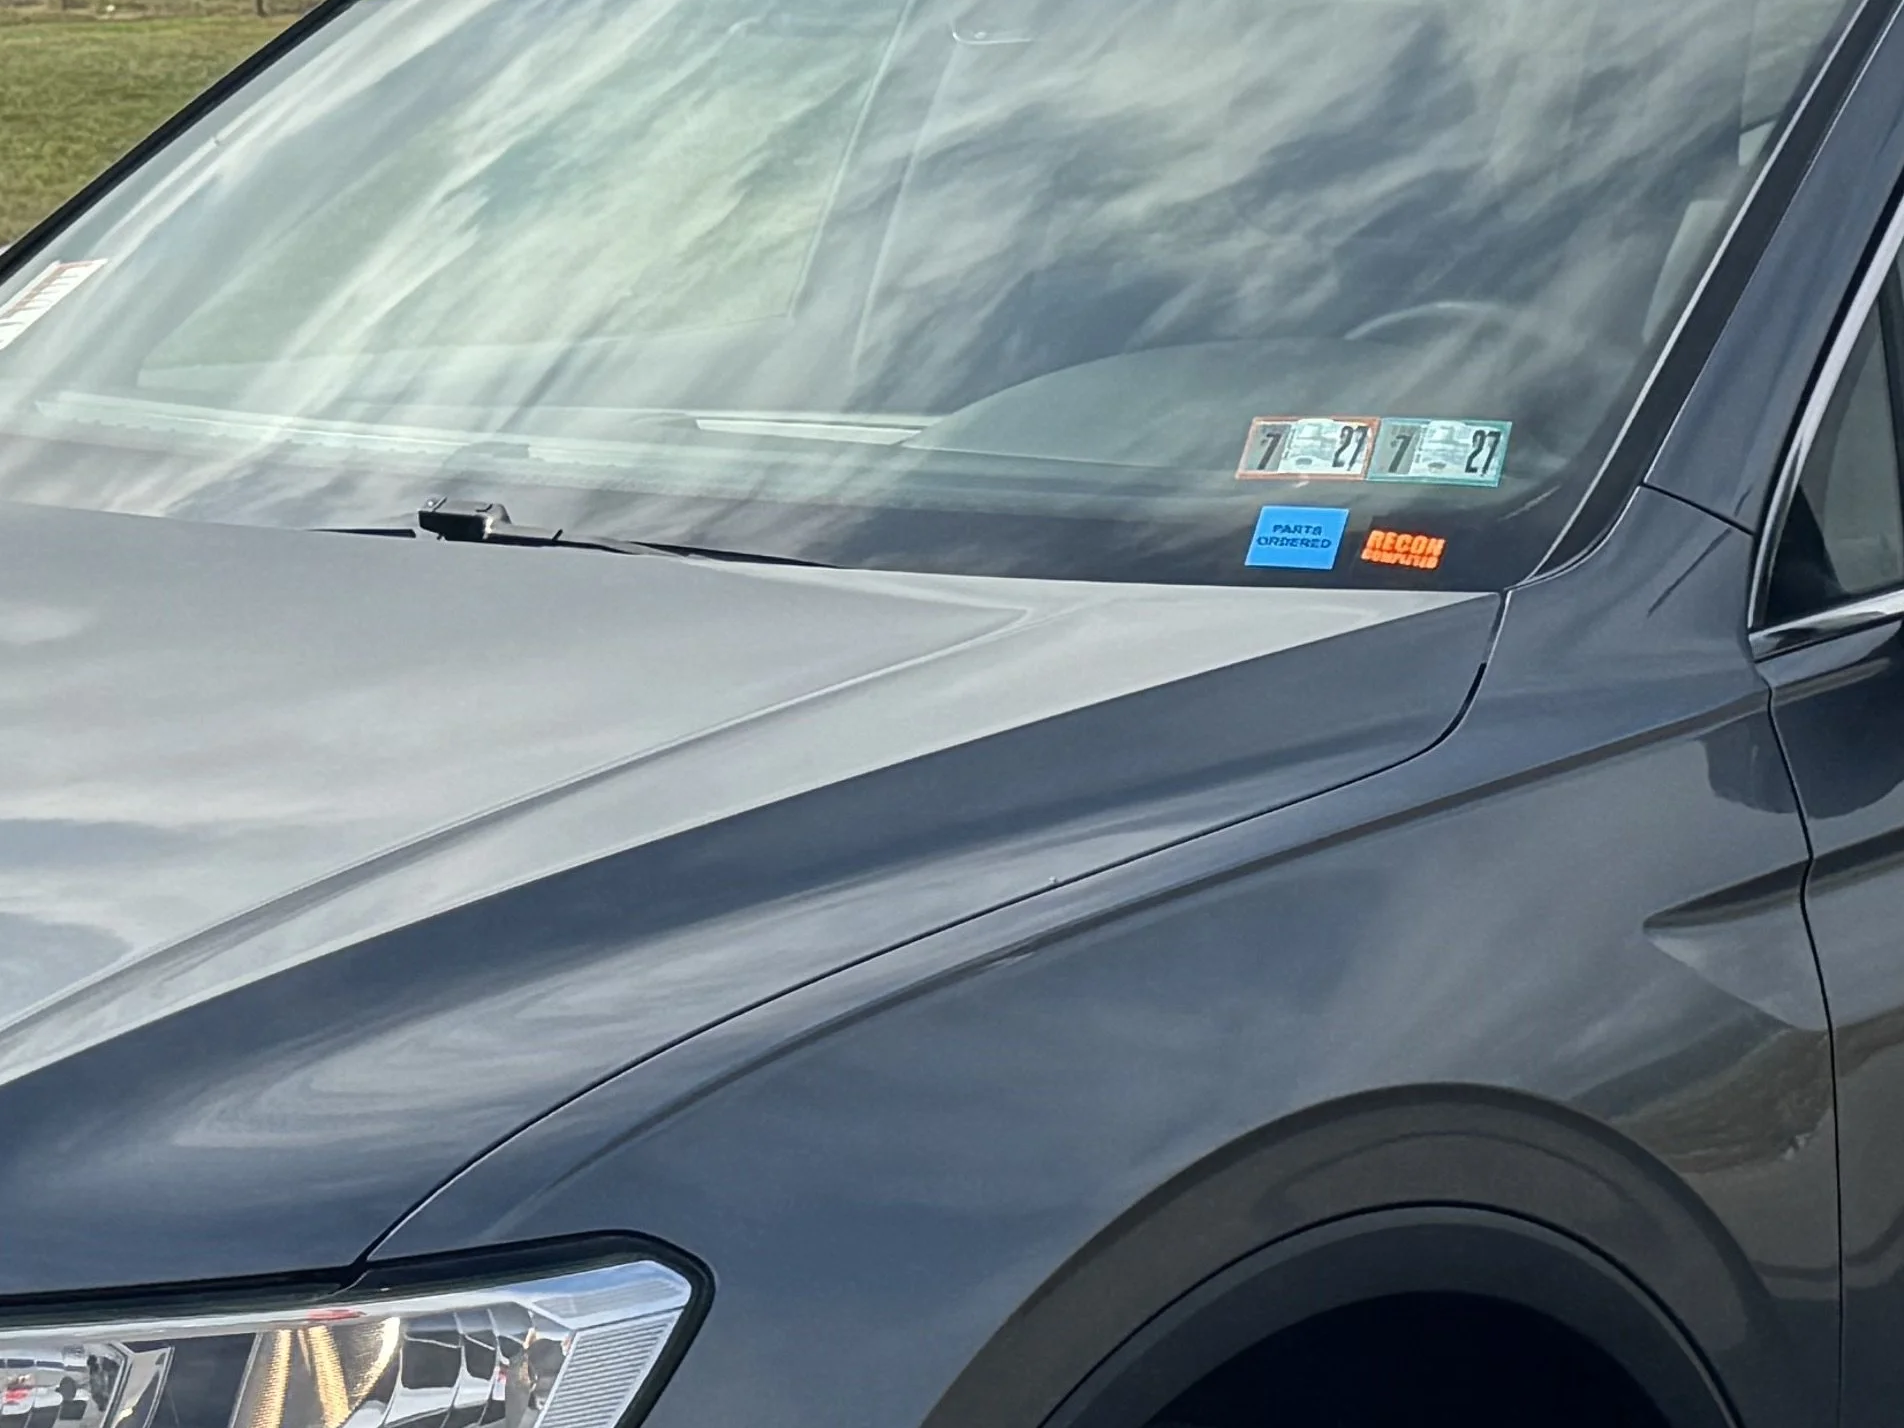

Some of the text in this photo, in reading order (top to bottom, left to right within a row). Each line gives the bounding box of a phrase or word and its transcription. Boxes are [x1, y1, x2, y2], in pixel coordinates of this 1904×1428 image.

[1257, 433, 1283, 470] 7
[1331, 425, 1370, 471] 27
[1388, 434, 1413, 473] 7
[1464, 429, 1502, 477] 27
[1256, 536, 1333, 549] ORDERED
[1272, 524, 1323, 536] PARTS
[1365, 529, 1446, 557] RECON
